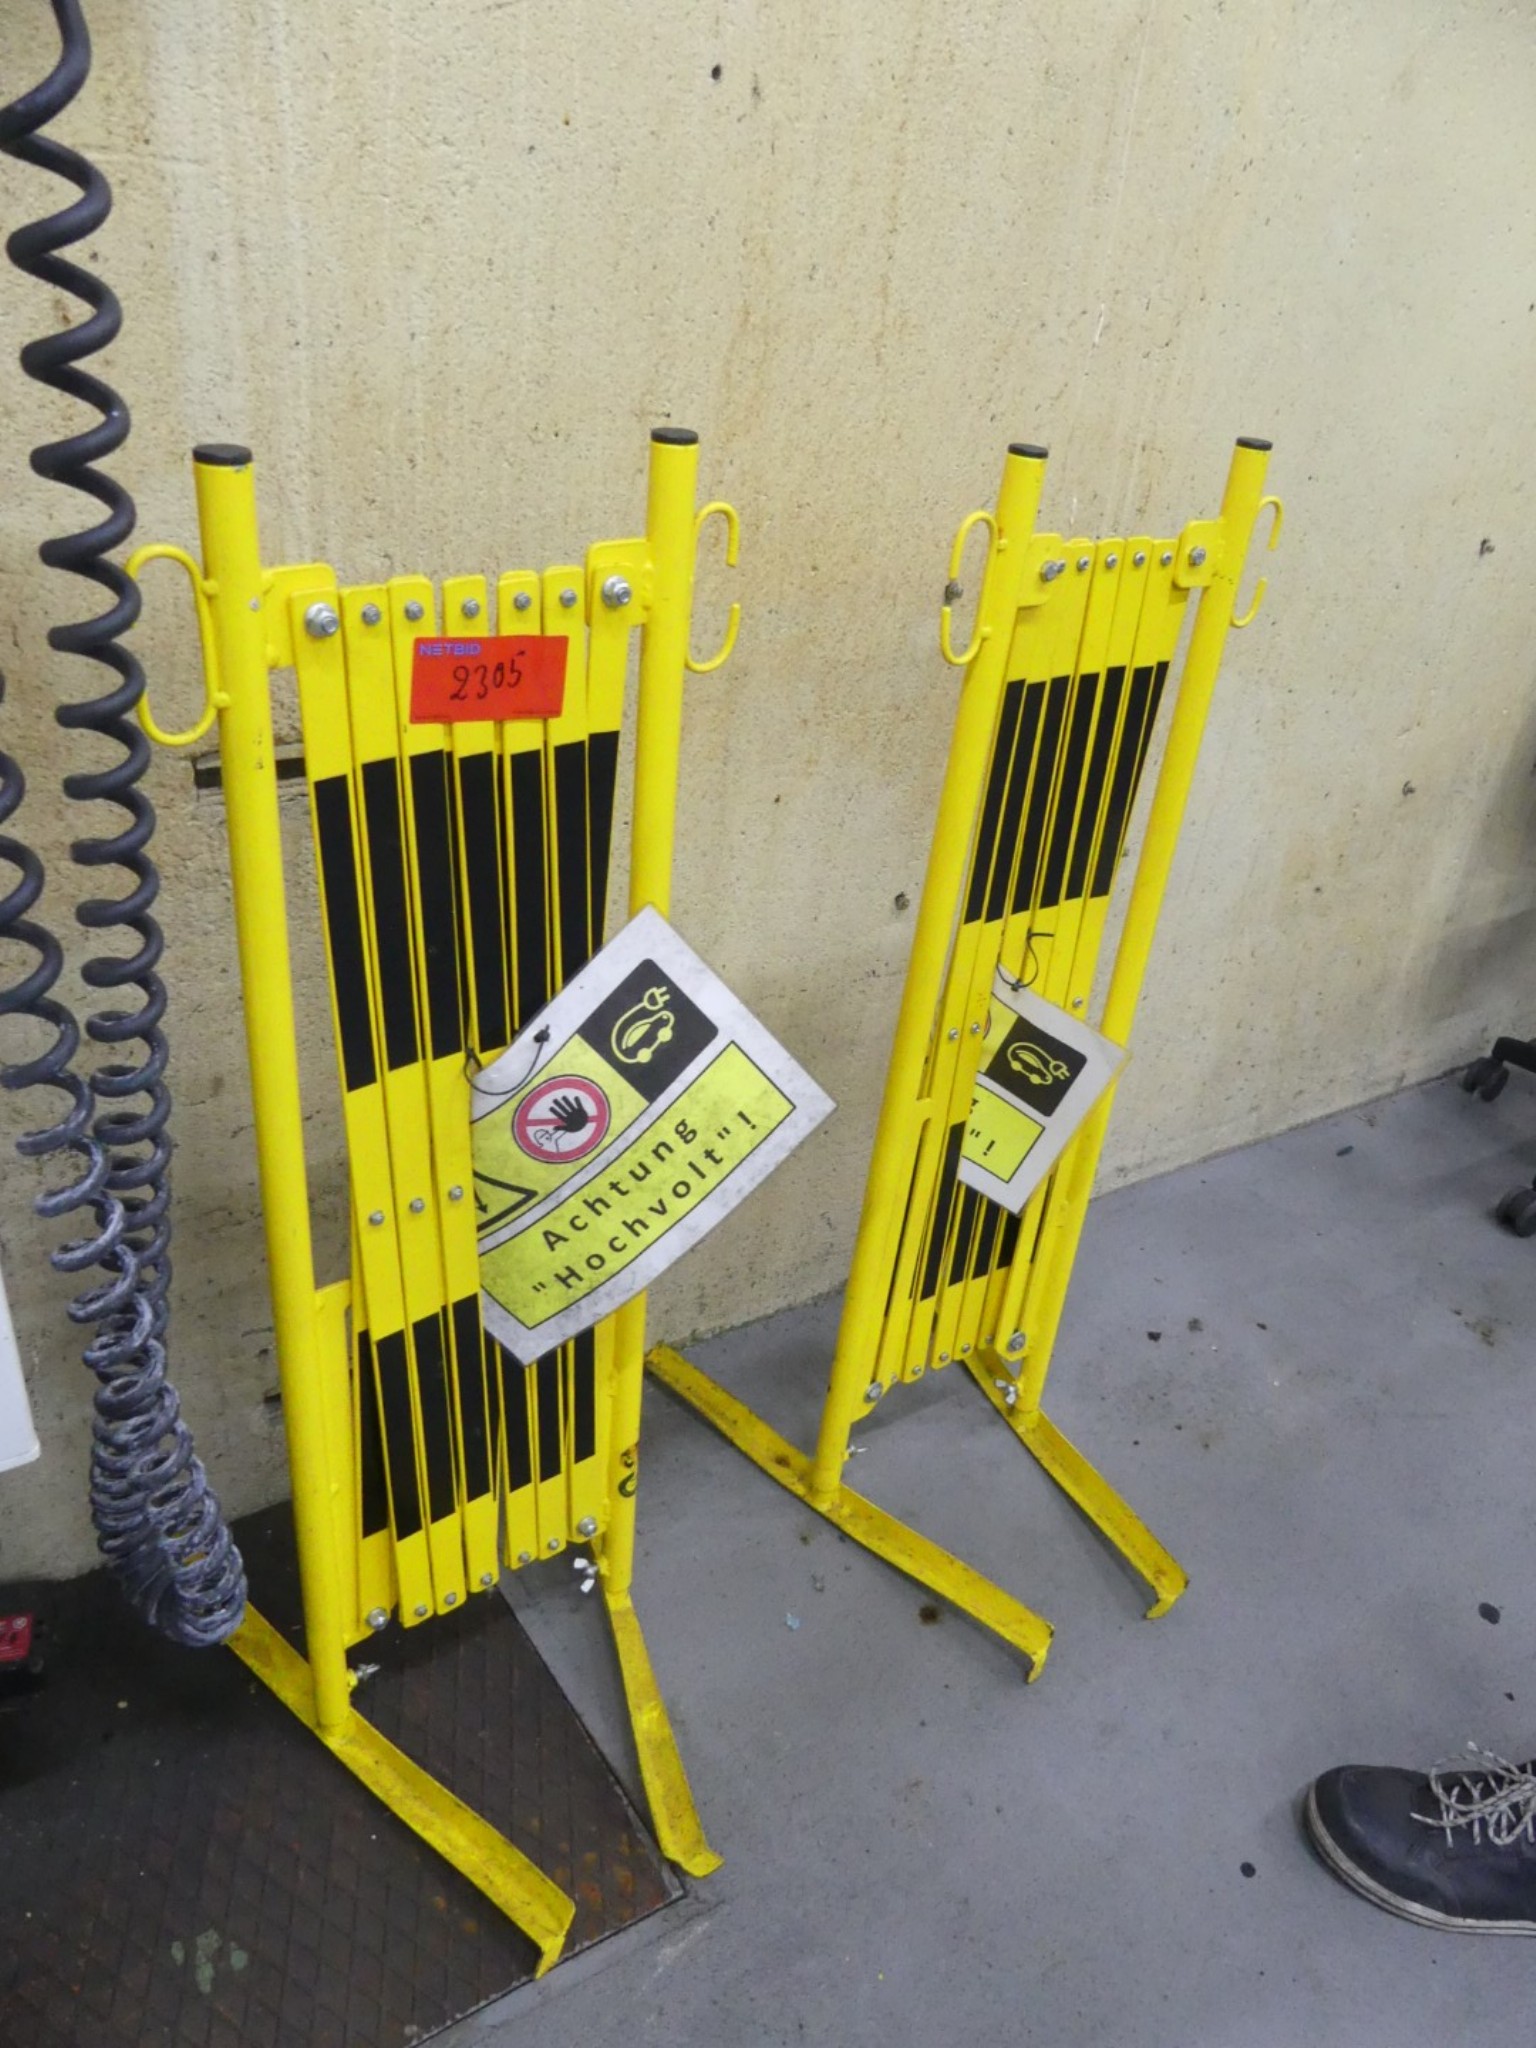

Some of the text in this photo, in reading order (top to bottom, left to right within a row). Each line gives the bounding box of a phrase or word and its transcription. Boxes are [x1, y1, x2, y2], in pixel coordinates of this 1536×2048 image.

[419, 643, 482, 656] NETBID
[450, 651, 526, 701] 2305
[542, 1118, 699, 1252] Achtung
